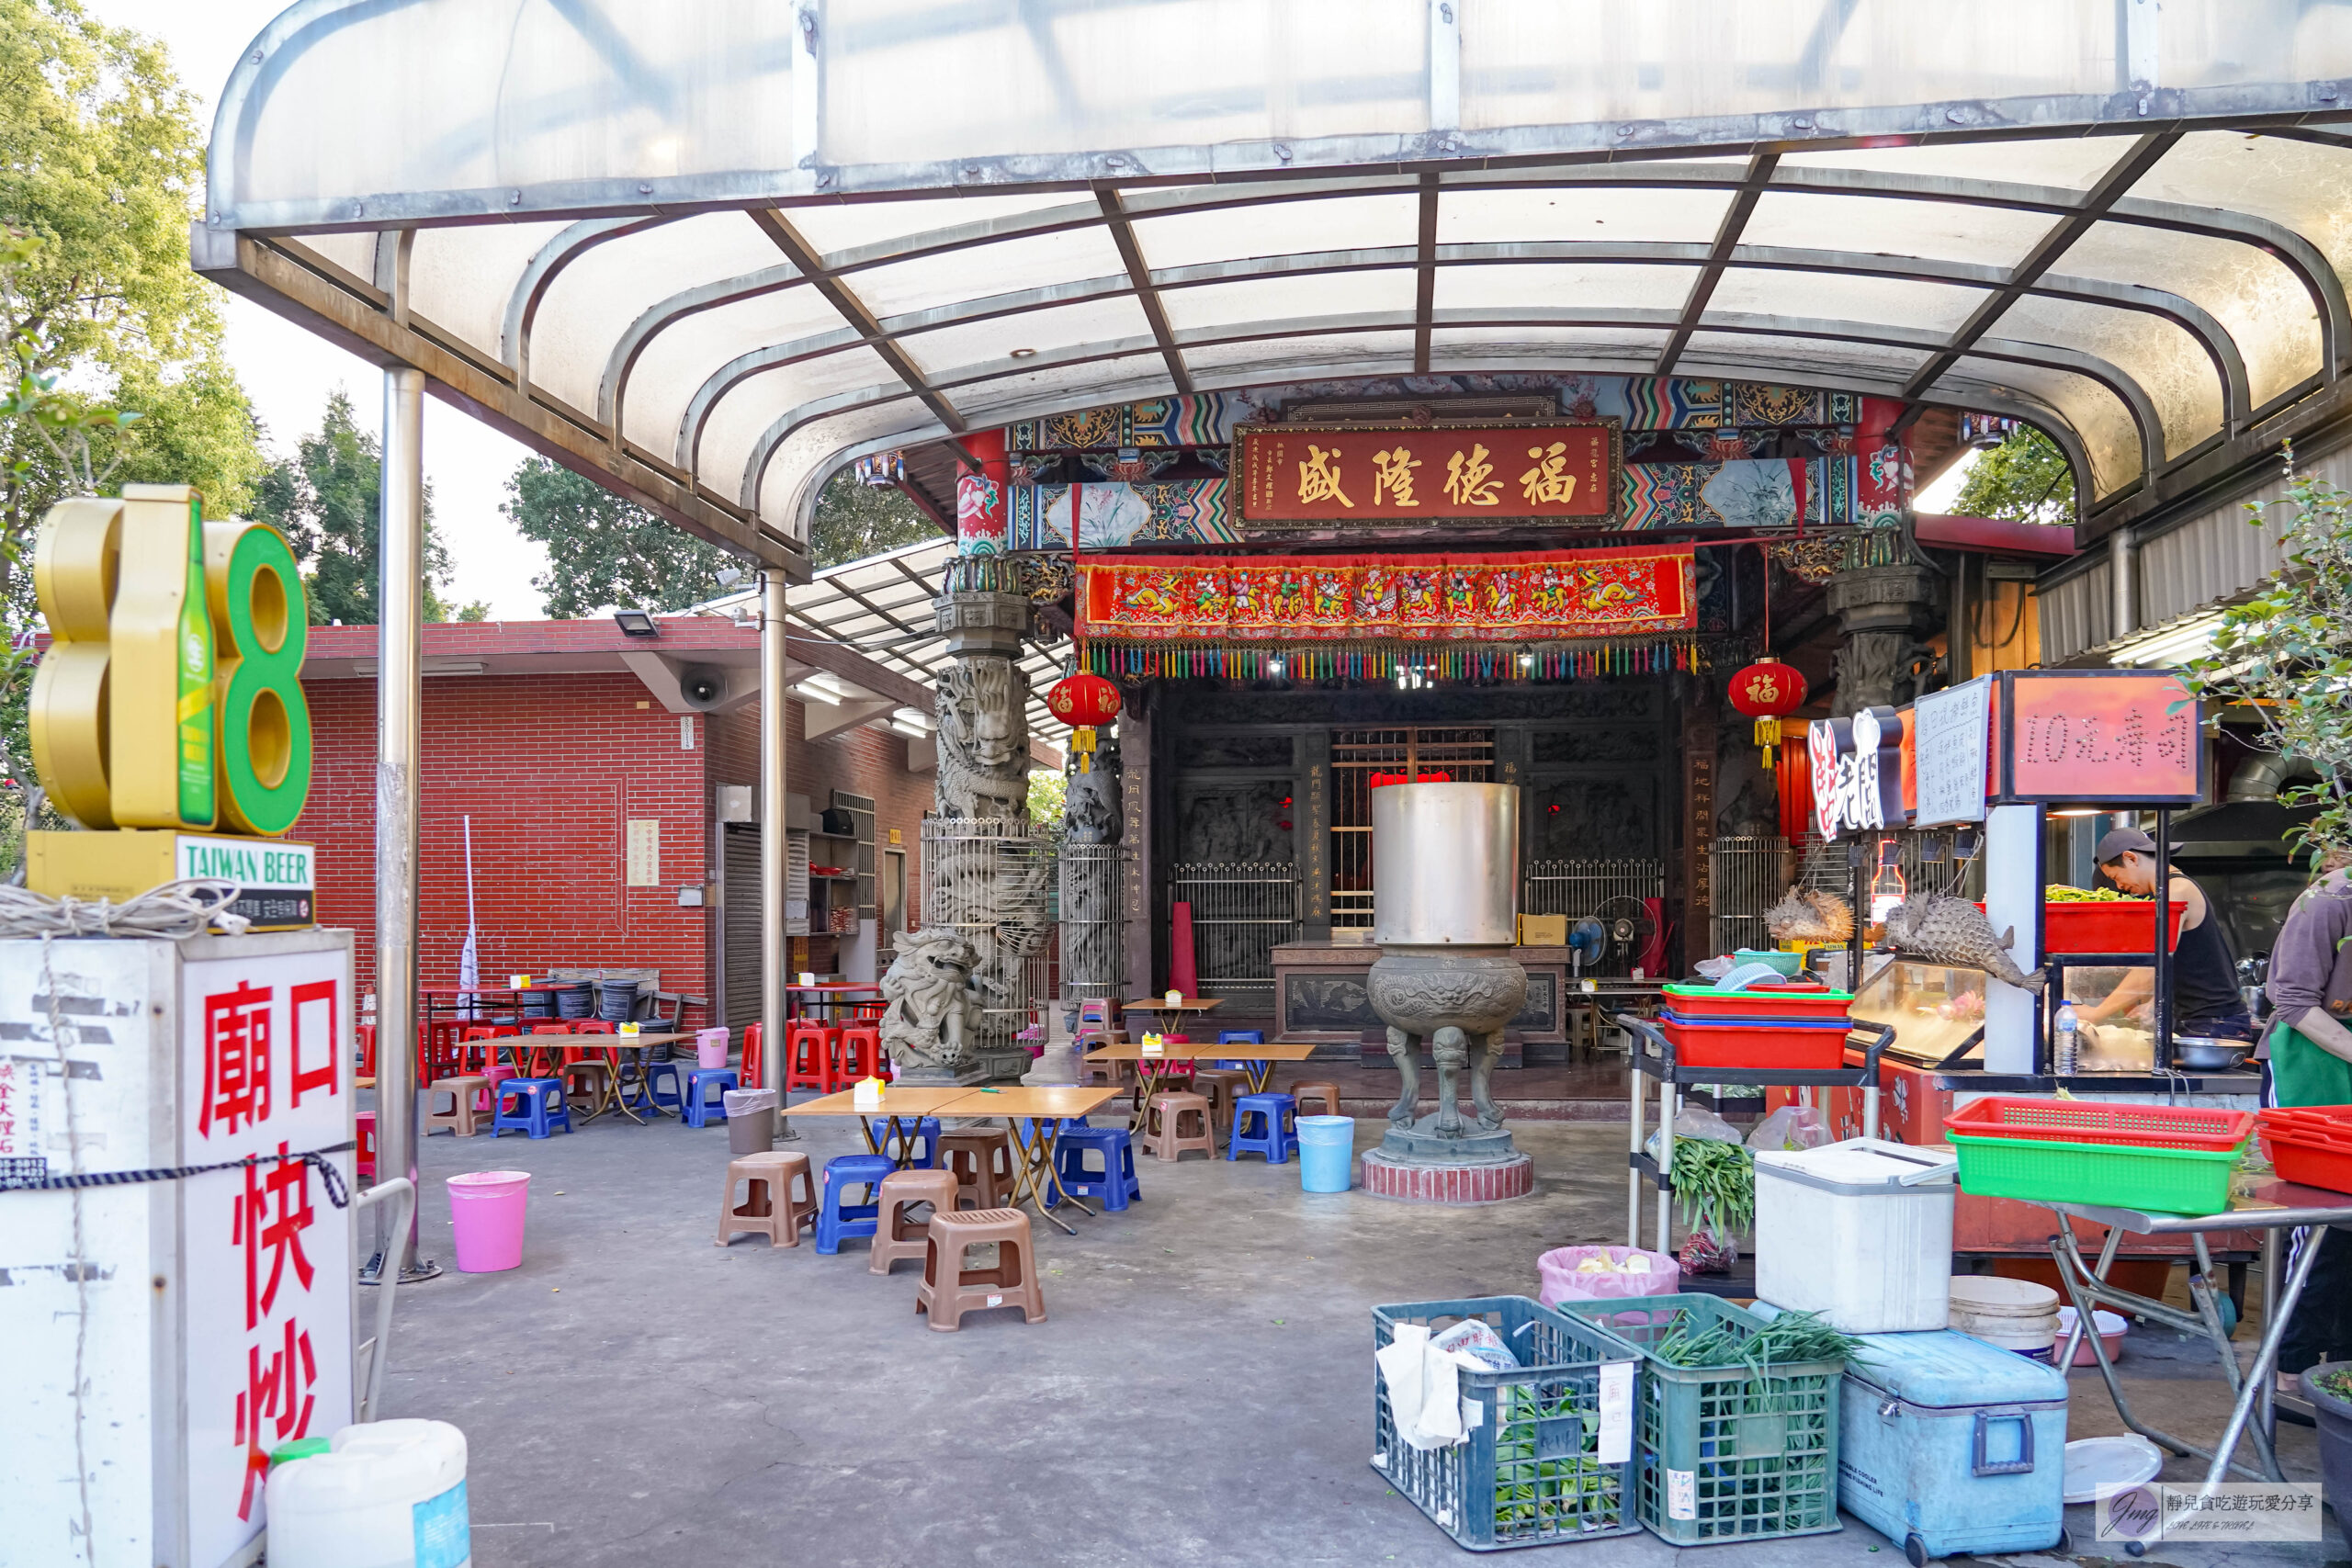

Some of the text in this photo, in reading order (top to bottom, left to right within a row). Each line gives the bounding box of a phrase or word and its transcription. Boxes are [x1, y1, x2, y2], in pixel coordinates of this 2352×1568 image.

[1298, 441, 1577, 508] 福德隆盛
[1746, 673, 1780, 705] 福
[186, 845, 308, 884] TAIWAN BEER
[198, 979, 338, 1142] 廟口
[232, 1140, 317, 1523] 快炒
